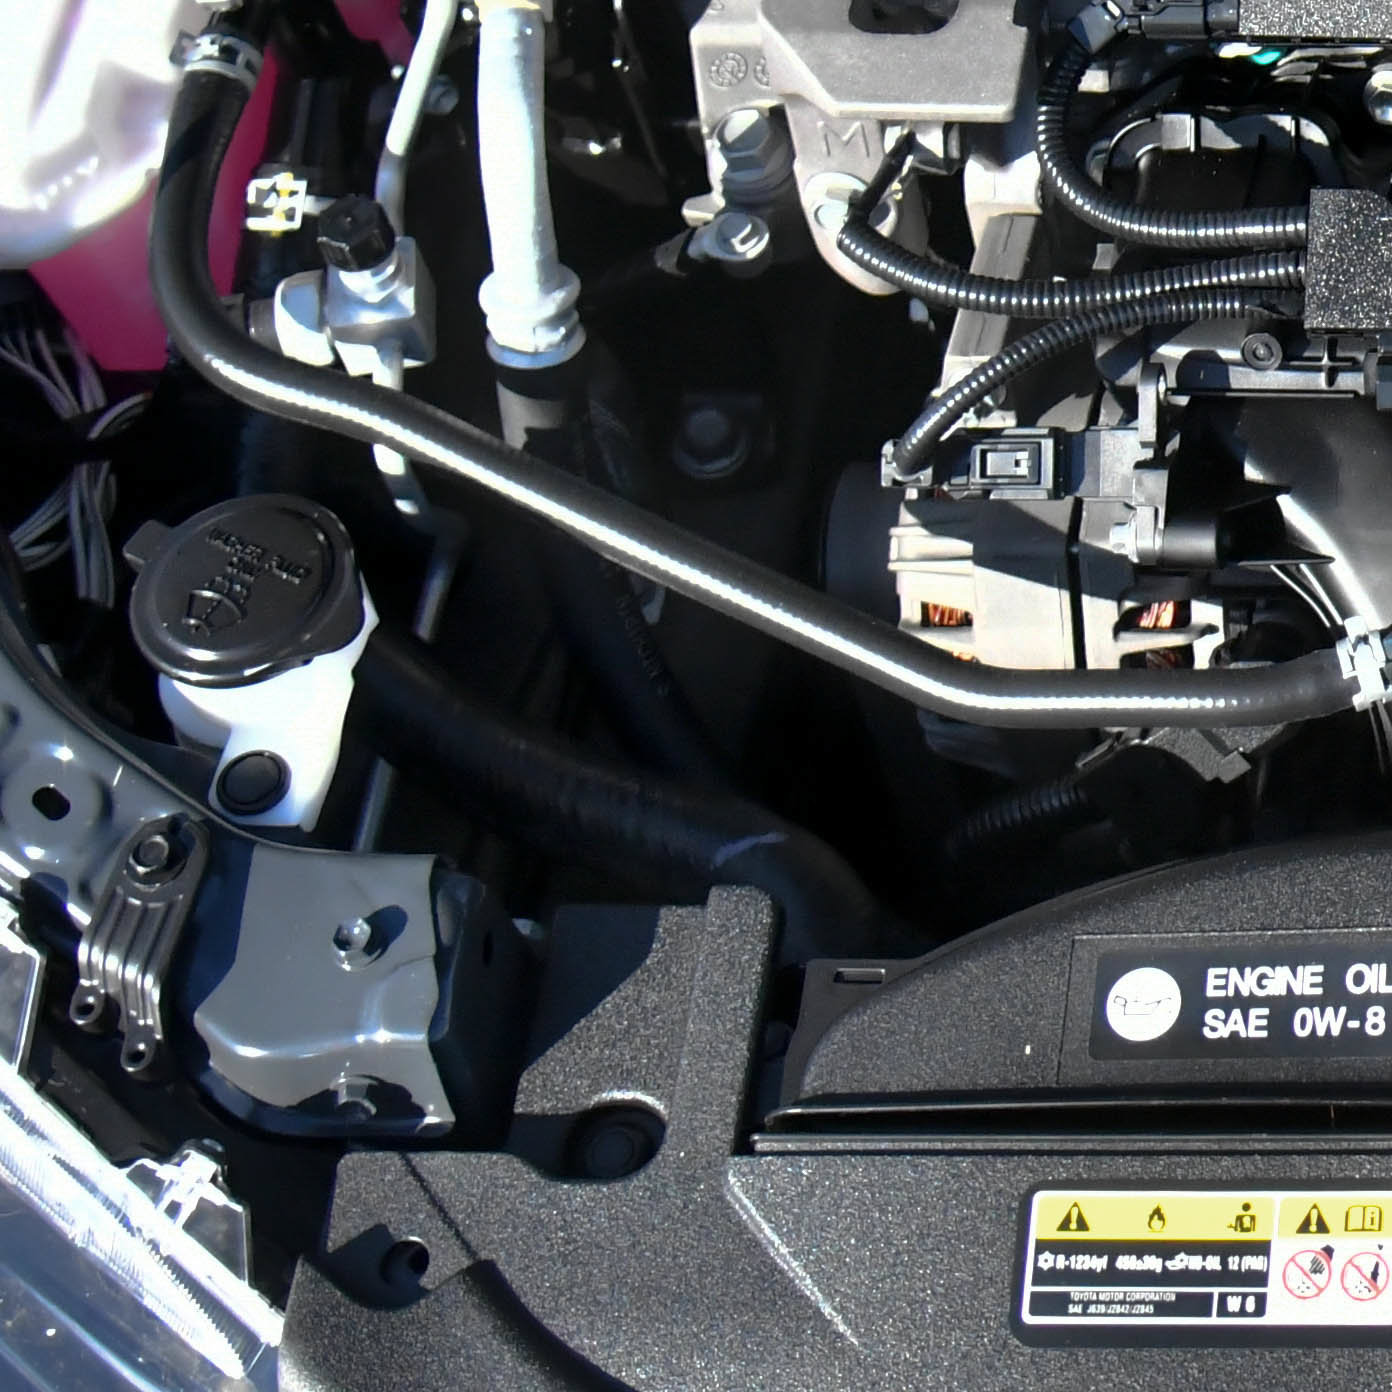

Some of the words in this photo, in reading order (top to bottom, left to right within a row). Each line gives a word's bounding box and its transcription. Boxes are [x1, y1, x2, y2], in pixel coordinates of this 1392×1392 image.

[1206, 965, 1324, 997] ENGINE
[1203, 1008, 1268, 1038] SAE
[1293, 1005, 1386, 1038] 0W-8
[1056, 1254, 1108, 1272] R-1234yf
[1228, 1255, 1239, 1270] 12
[1070, 1292, 1097, 1301] TOYOTA
[1098, 1292, 1125, 1301] MOTOR
[1125, 1292, 1176, 1301] CORPORATION
[1226, 1295, 1241, 1312] W
[1068, 1304, 1083, 1314] SAE
